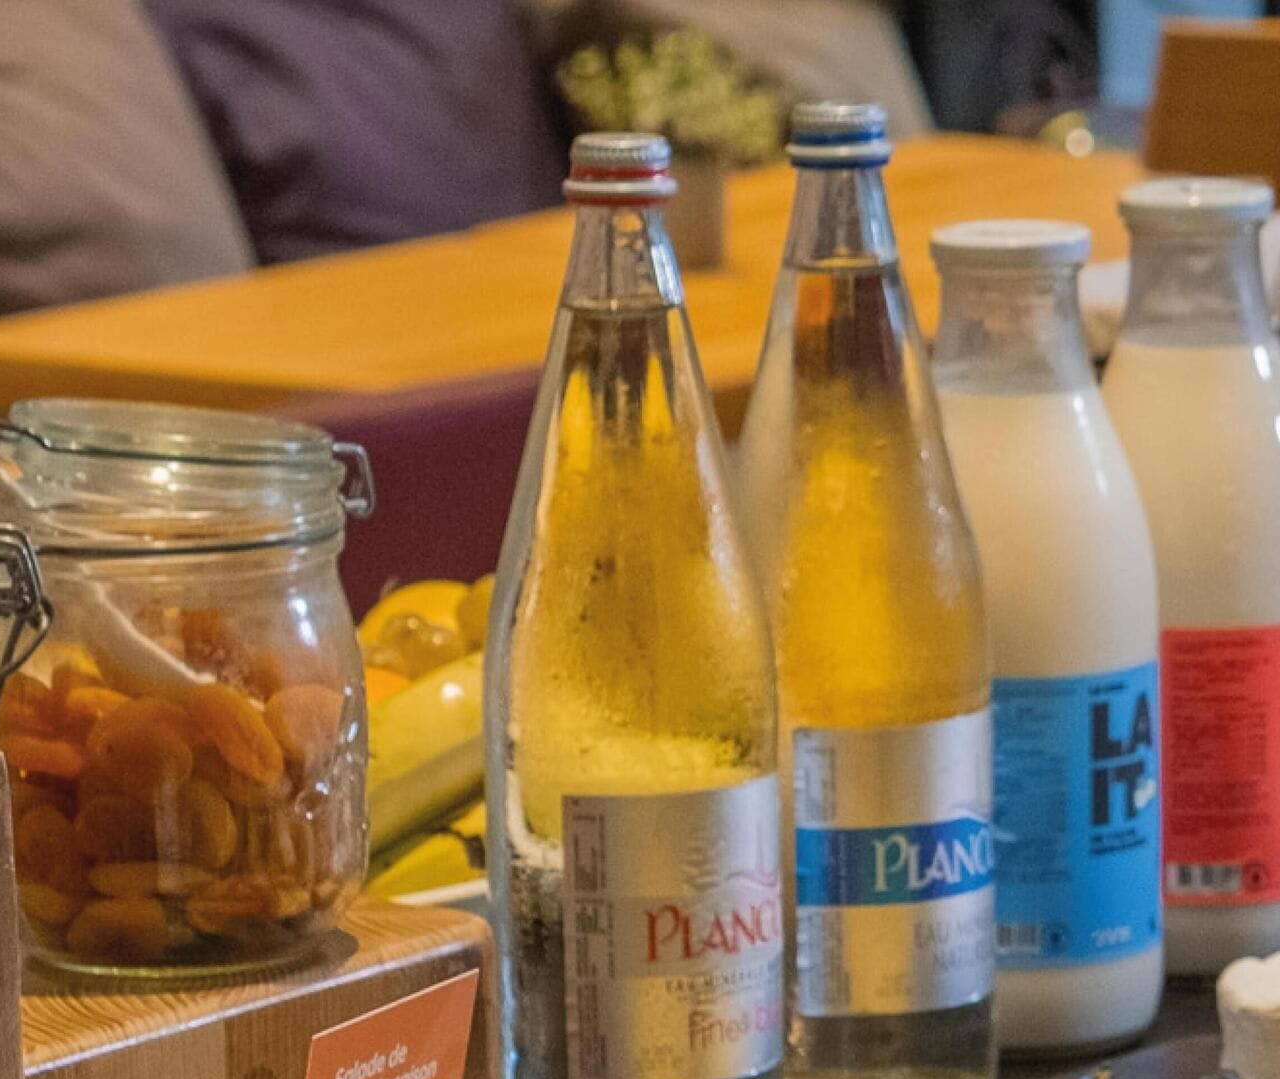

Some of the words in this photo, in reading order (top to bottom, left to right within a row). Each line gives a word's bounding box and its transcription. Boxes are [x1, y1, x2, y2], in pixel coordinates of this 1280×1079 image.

[1090, 690, 1152, 763] LA
[1090, 759, 1146, 827] IT
[387, 1042, 408, 1069] de
